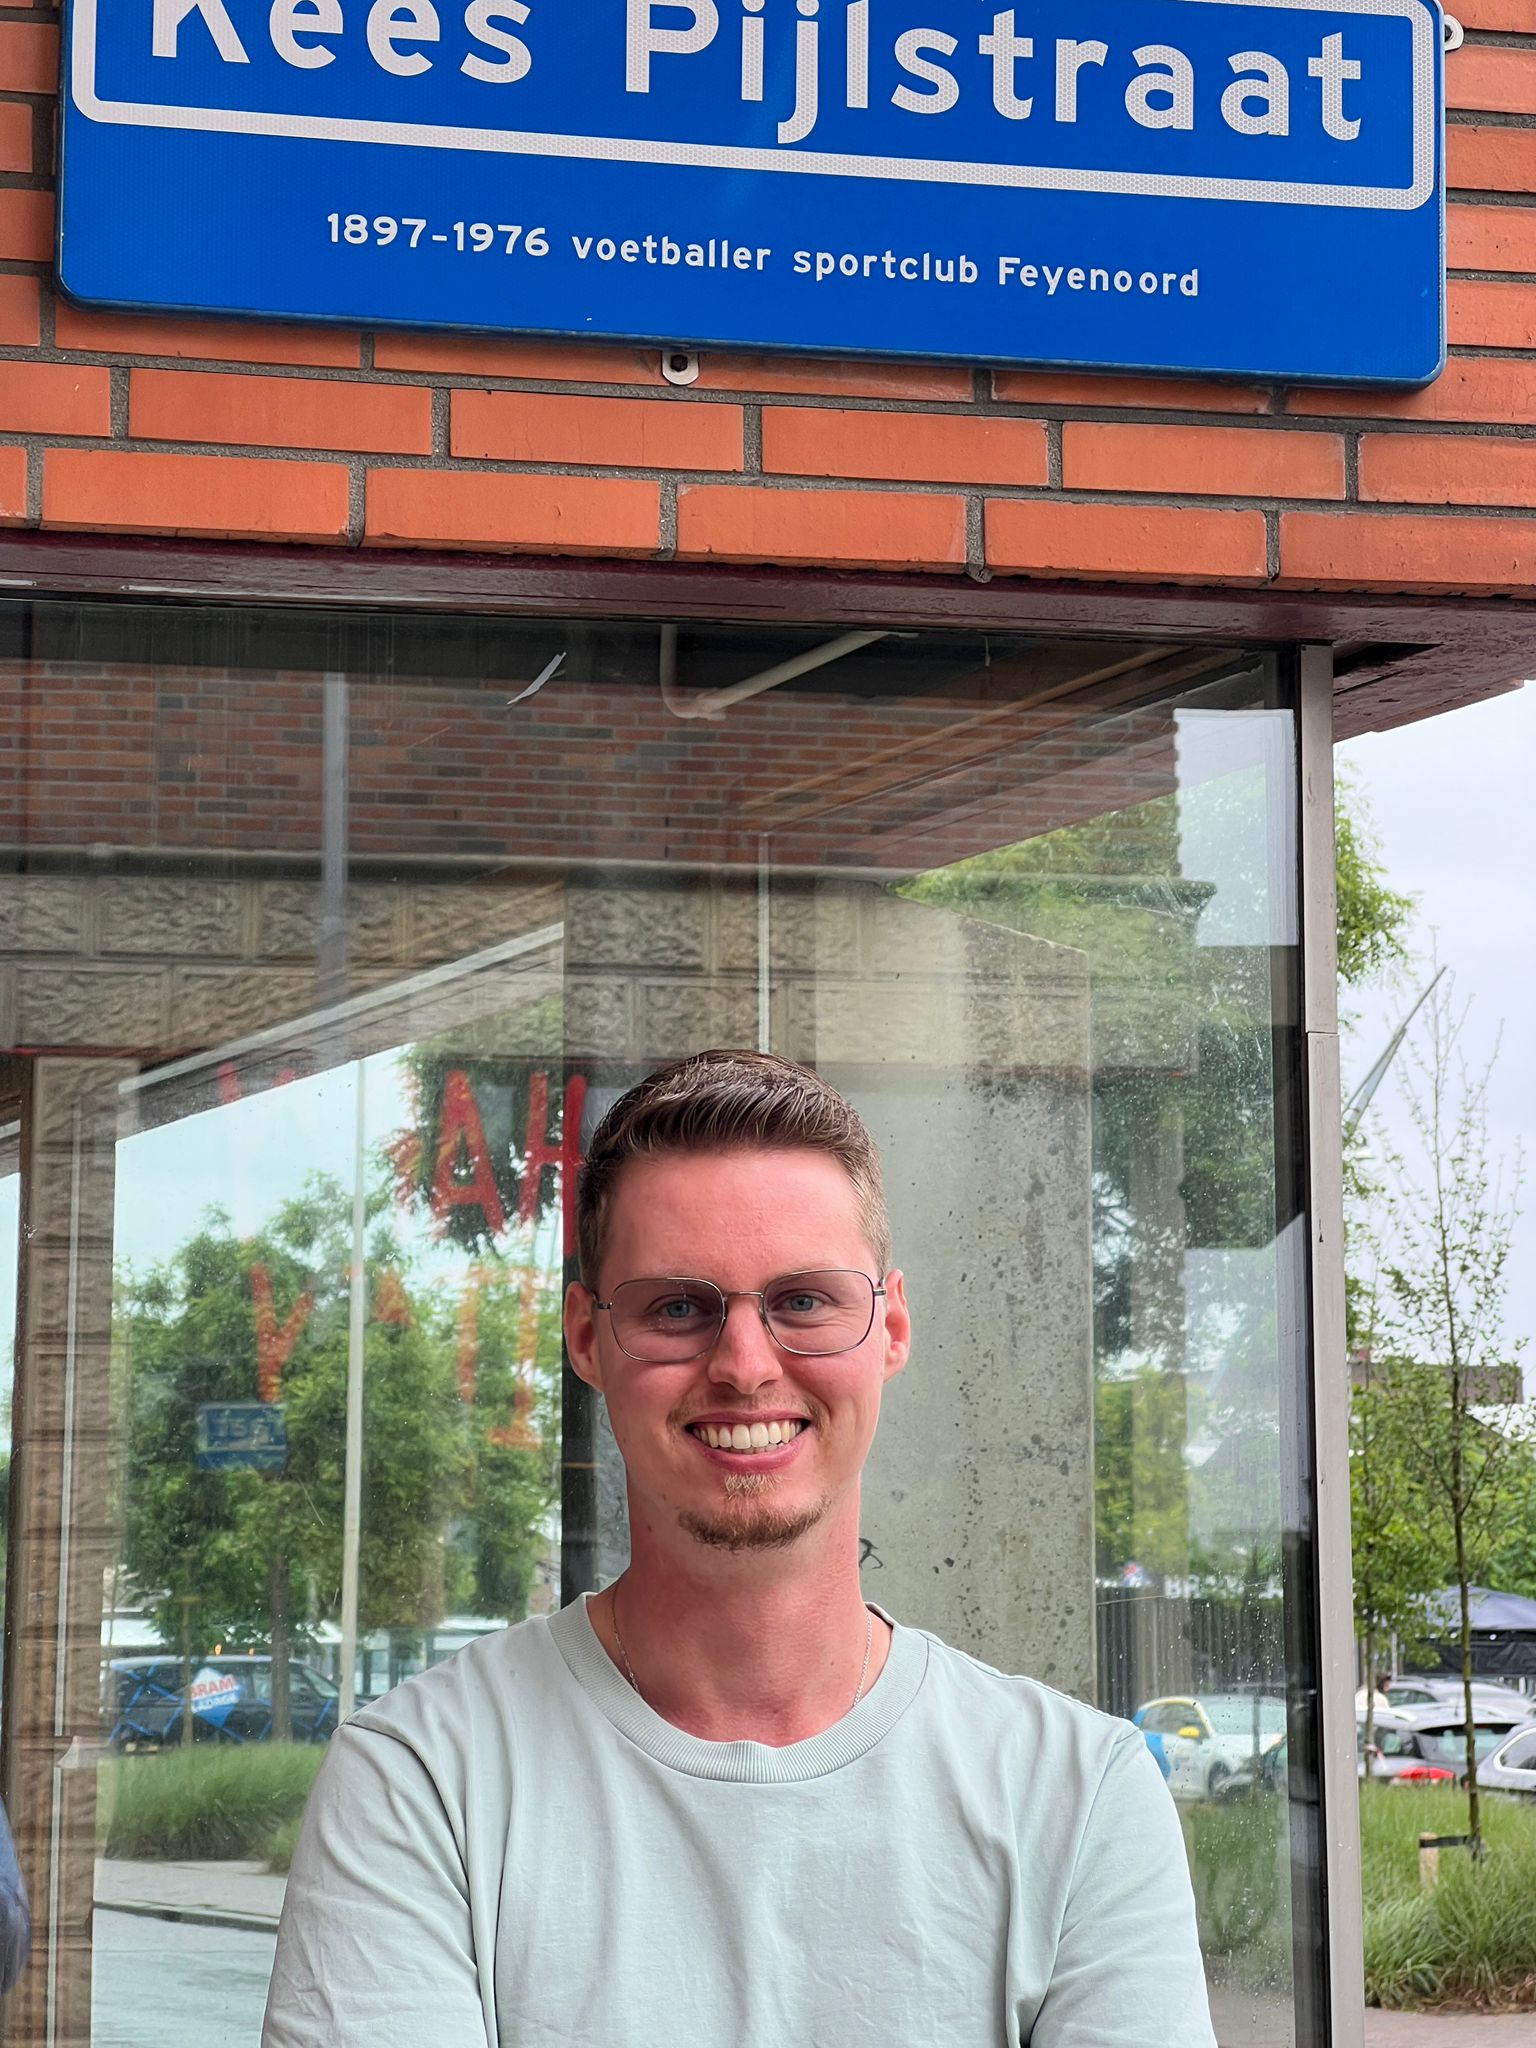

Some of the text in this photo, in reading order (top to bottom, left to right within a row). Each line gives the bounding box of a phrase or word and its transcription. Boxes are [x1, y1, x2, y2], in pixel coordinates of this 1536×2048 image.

[625, 0, 1362, 144] Pijlstraat
[327, 213, 1199, 297] 1897-1976 voetballer sportclub Feyenoord
